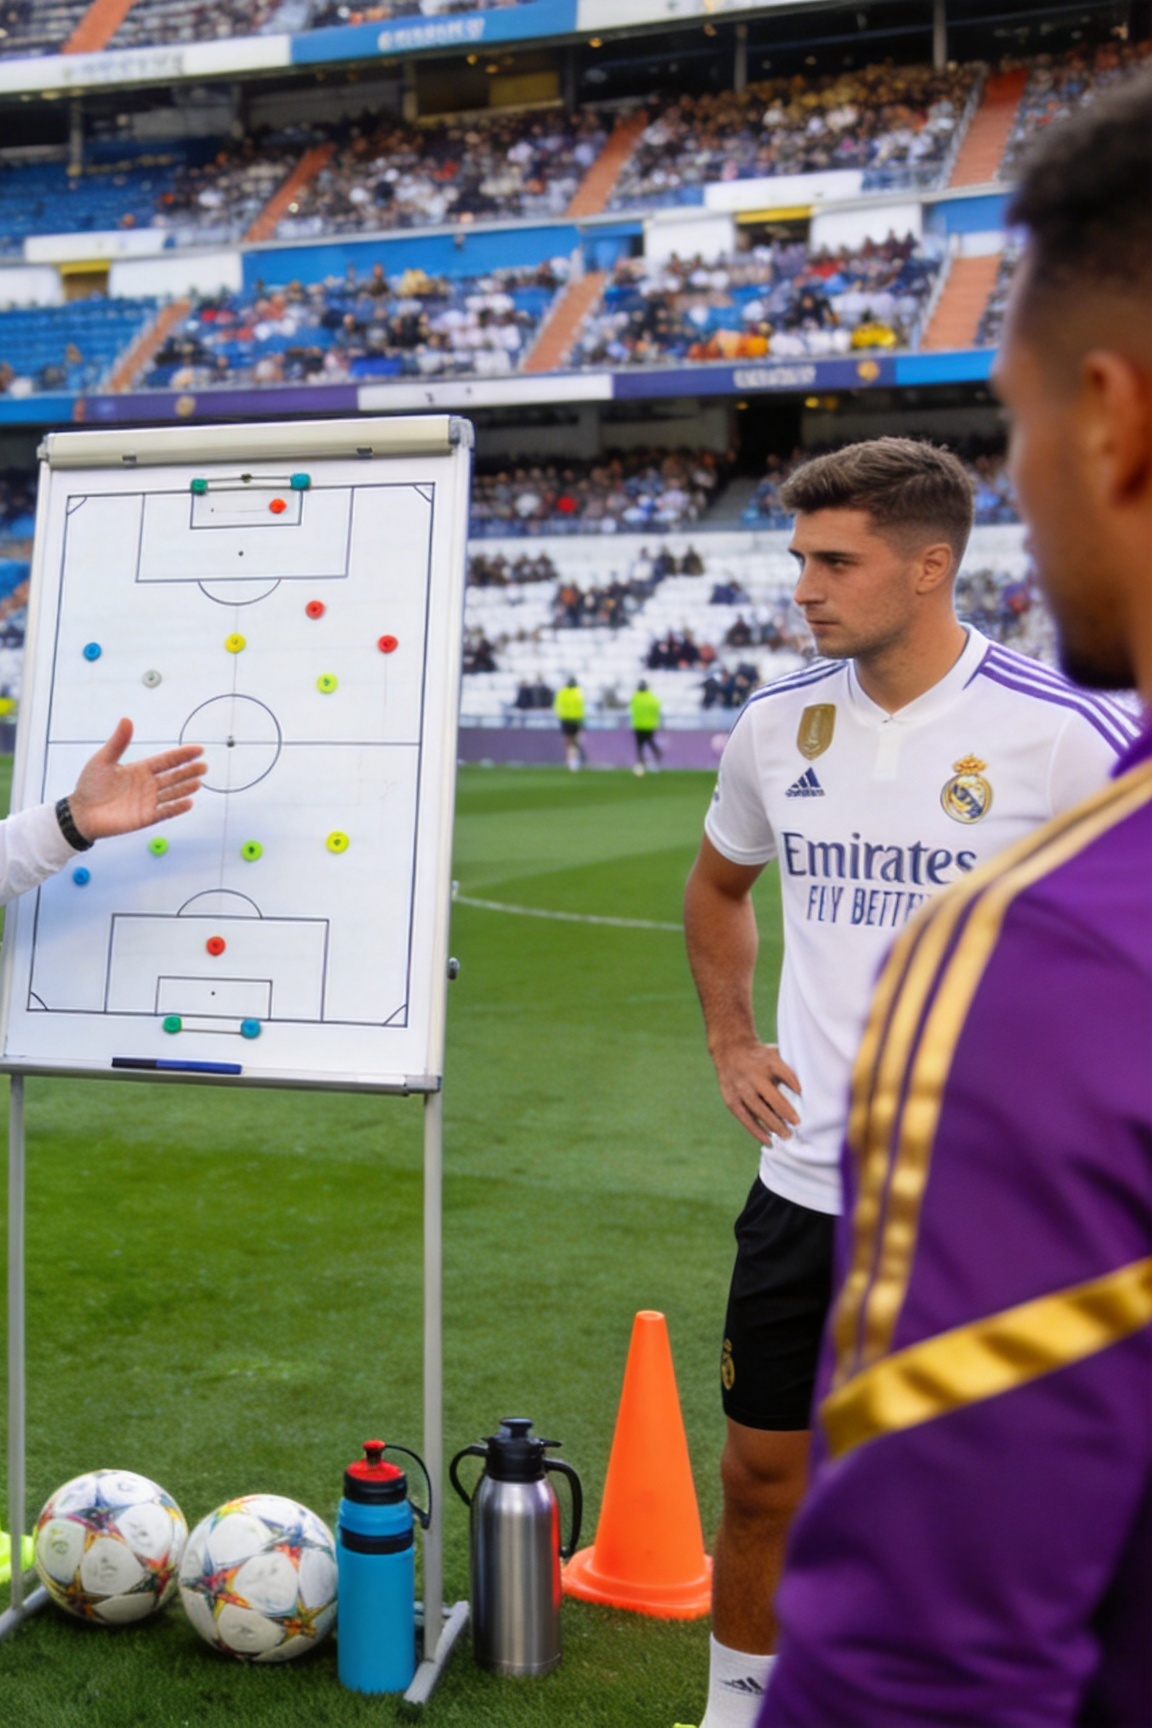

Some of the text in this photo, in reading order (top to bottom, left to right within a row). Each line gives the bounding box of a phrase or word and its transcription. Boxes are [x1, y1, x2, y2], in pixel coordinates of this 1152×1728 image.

[781, 832, 977, 886] Emirates
[806, 885, 931, 927] FLY BETT
